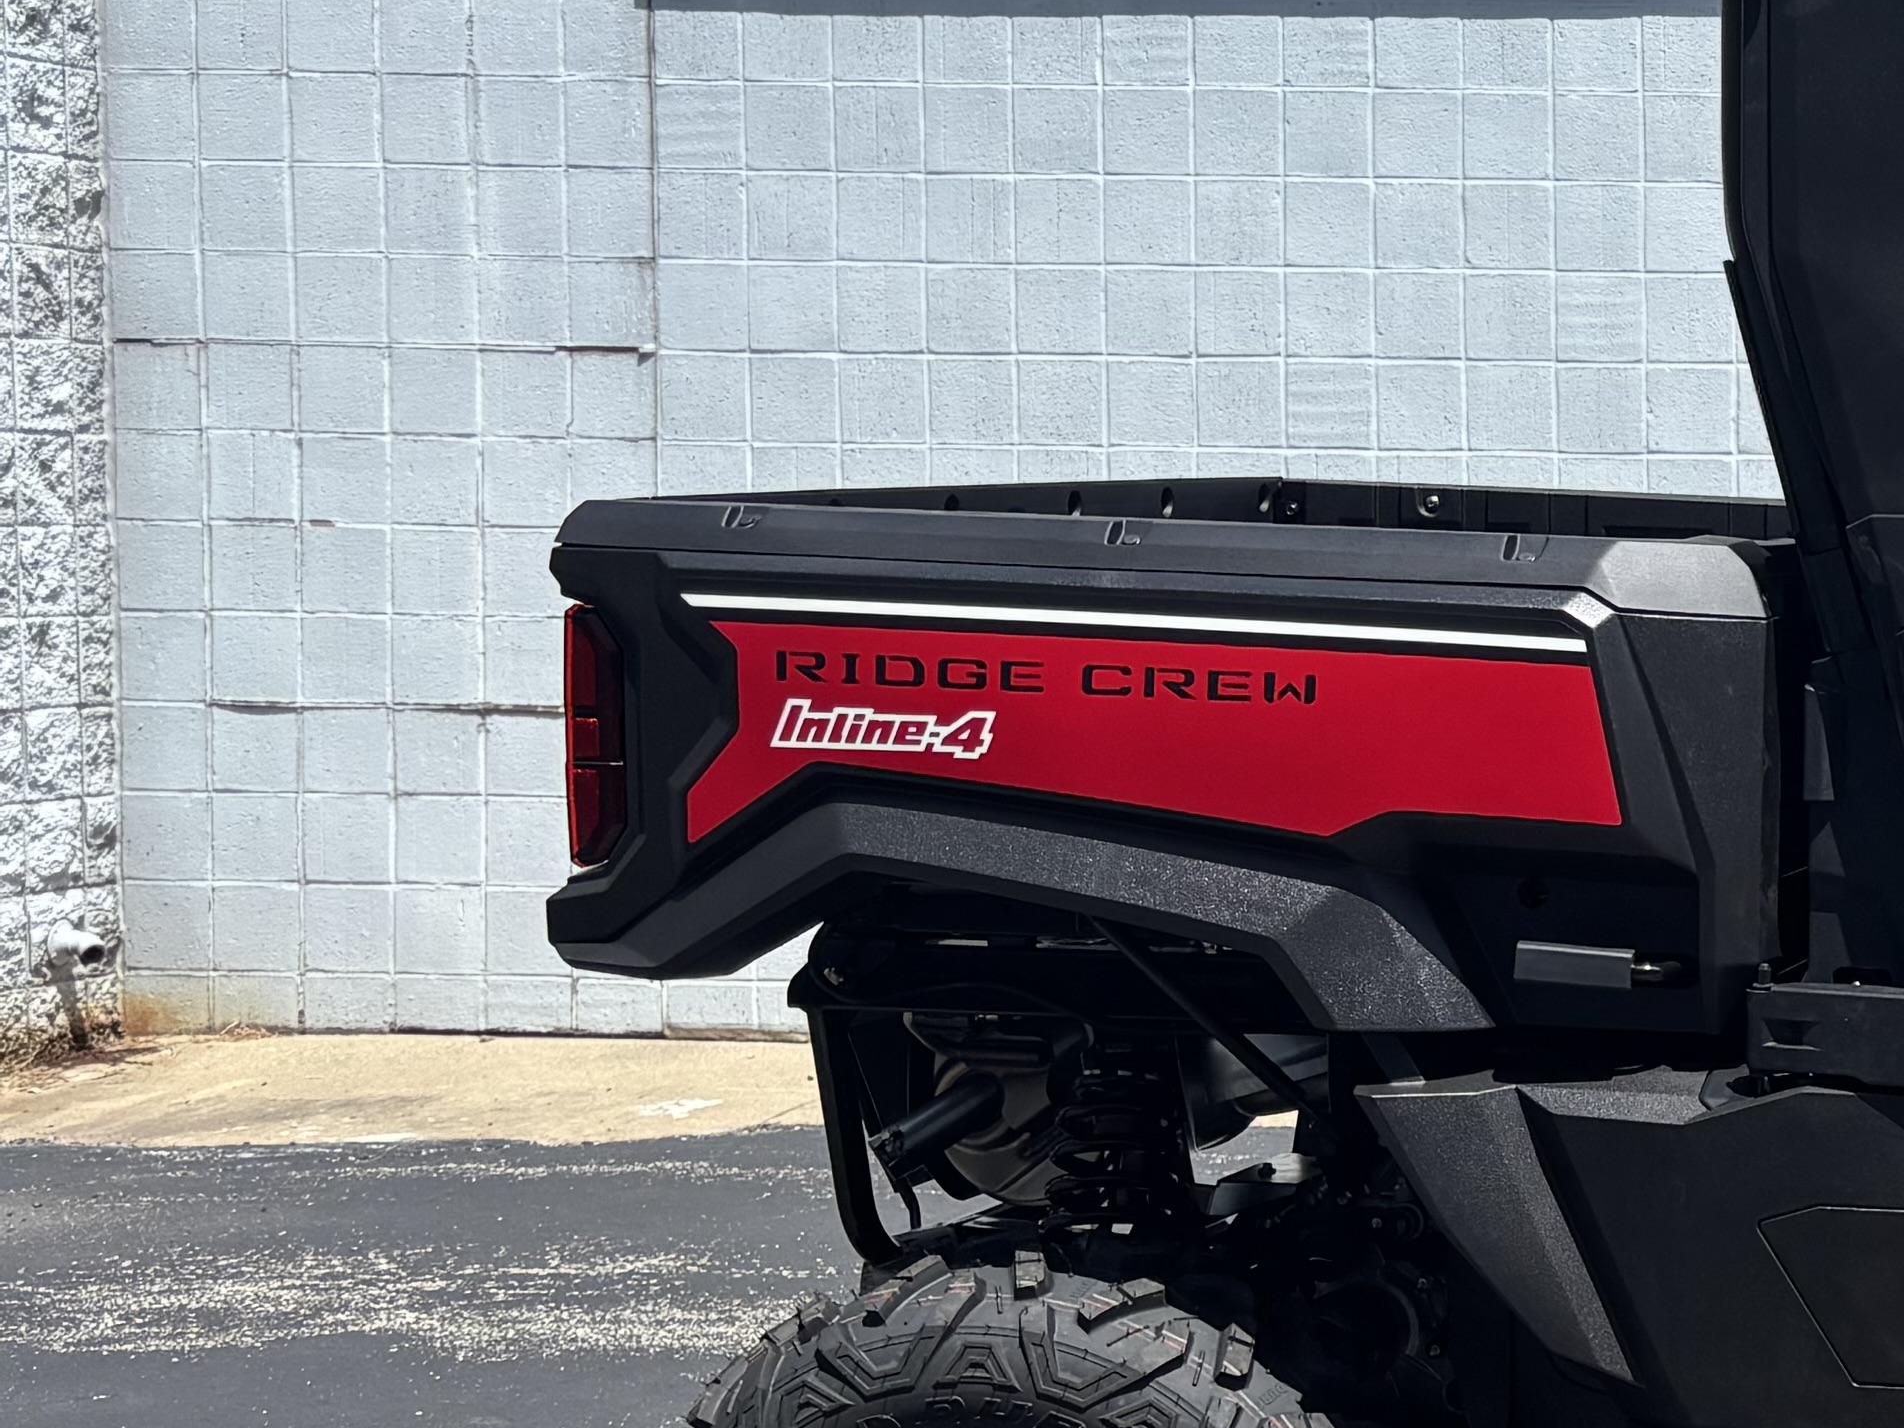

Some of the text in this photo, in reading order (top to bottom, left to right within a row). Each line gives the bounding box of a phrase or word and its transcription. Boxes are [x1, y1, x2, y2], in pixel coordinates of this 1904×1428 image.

[775, 649, 1318, 705] RIDGE CREW
[770, 698, 997, 760] Inline-4
